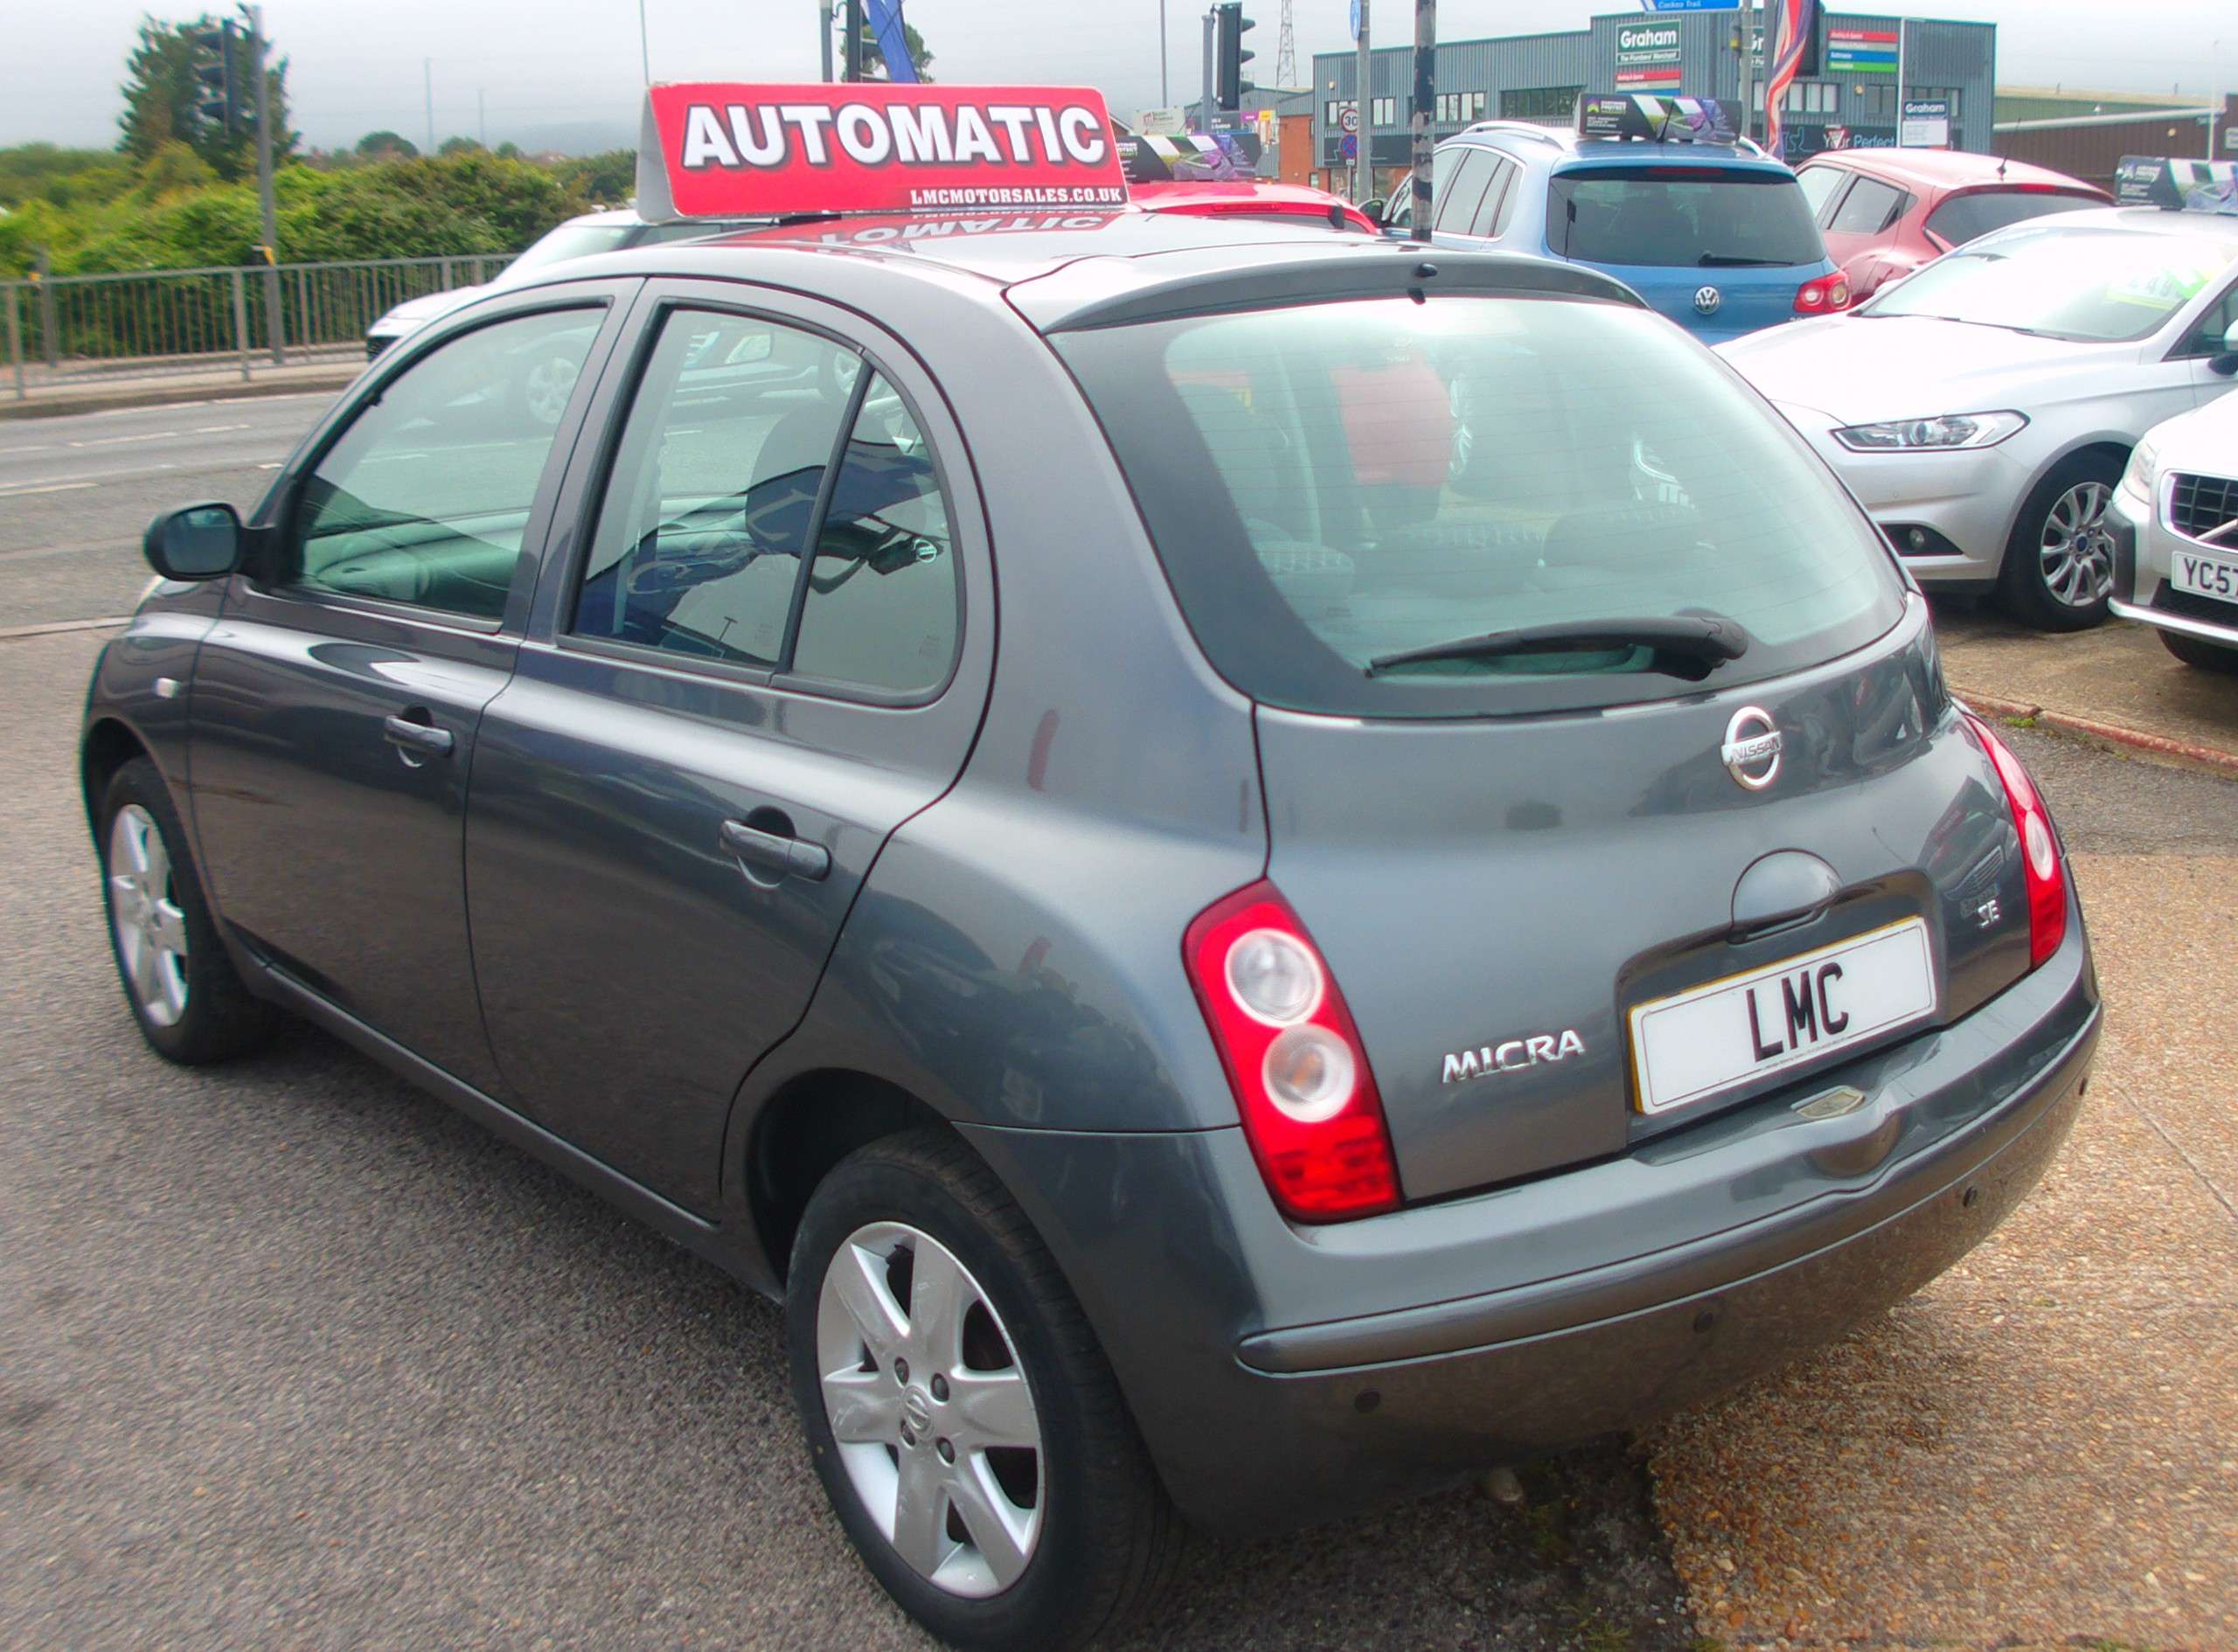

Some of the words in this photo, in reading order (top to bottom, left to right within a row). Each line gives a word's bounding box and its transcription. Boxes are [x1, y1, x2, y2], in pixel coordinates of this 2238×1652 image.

[1621, 29, 1677, 48] Graham
[1905, 103, 1945, 114] Graham
[1345, 116, 1358, 127] 30
[683, 104, 1103, 167] AUTOMATIC
[1853, 135, 1894, 147] Perfect
[910, 188, 1122, 205] LMCMOTORSALES.CO.UK
[1733, 738, 1780, 760] NISSAN
[1746, 961, 1849, 1063] LMC
[1442, 1030, 1586, 1083] MICRA
